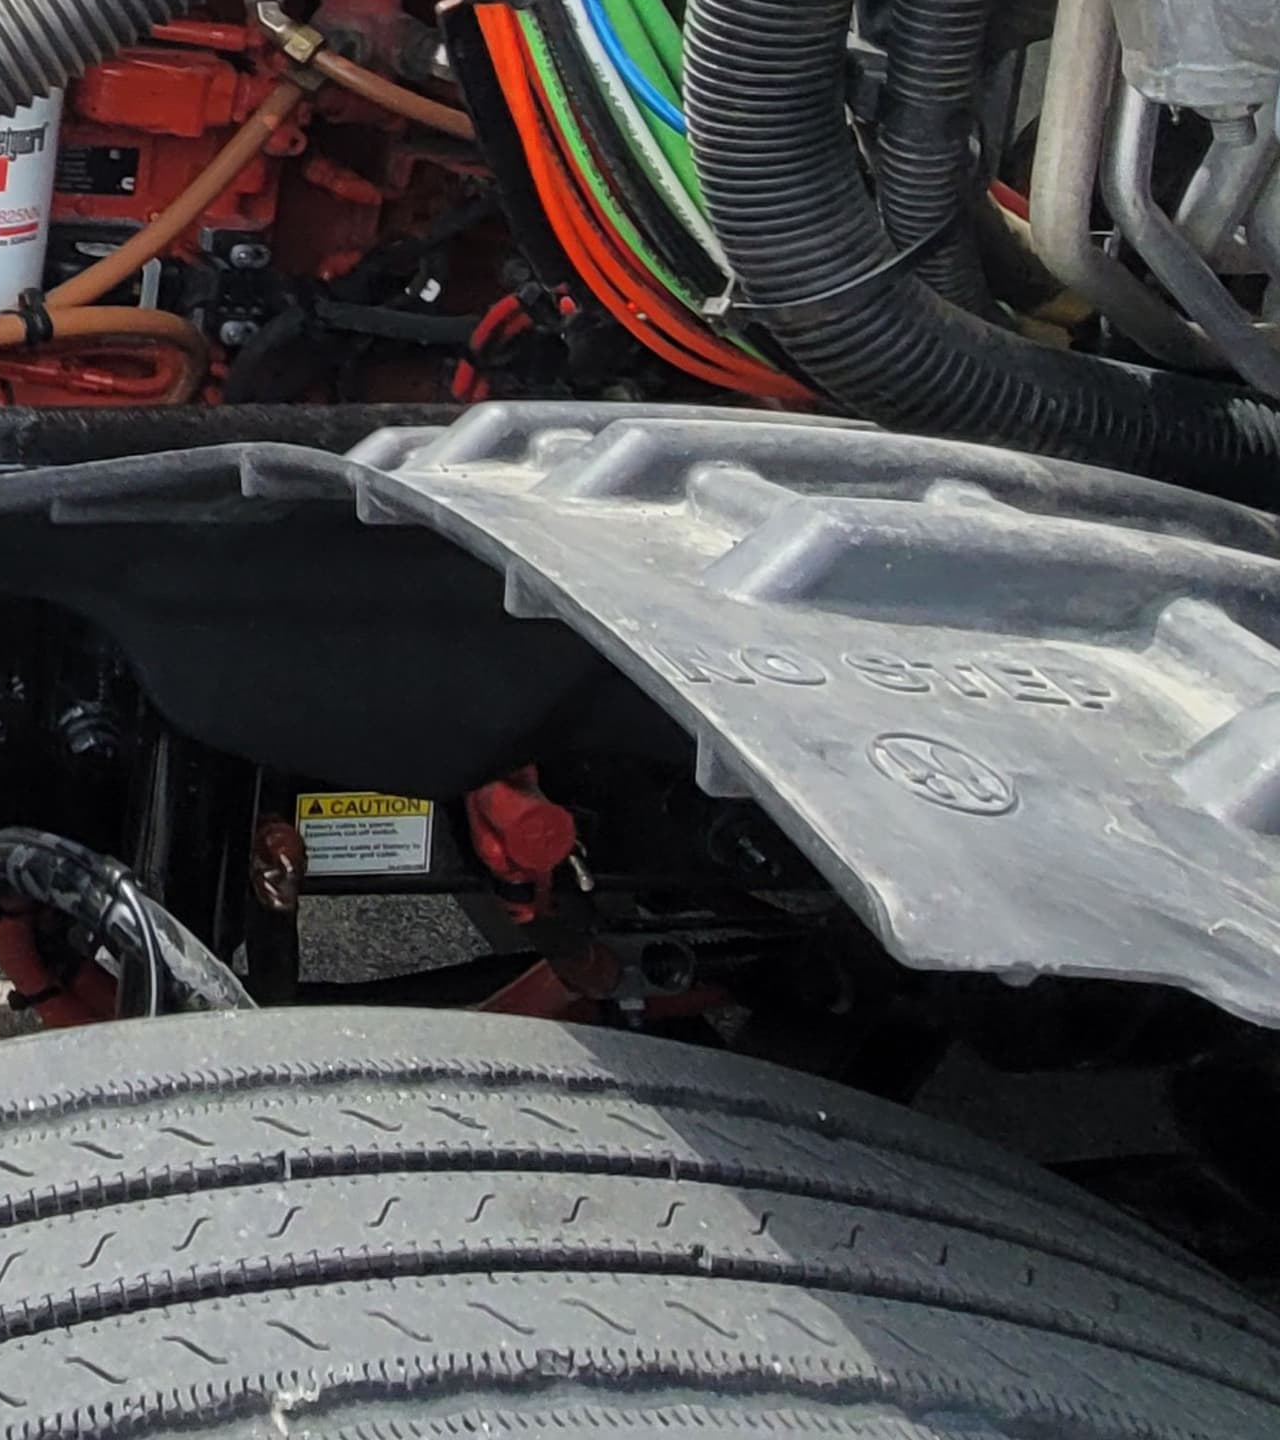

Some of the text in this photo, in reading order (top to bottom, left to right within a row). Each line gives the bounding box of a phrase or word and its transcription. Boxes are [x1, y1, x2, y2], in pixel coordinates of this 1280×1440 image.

[645, 643, 1114, 711] NO STEP
[330, 799, 421, 815] CAUTION
